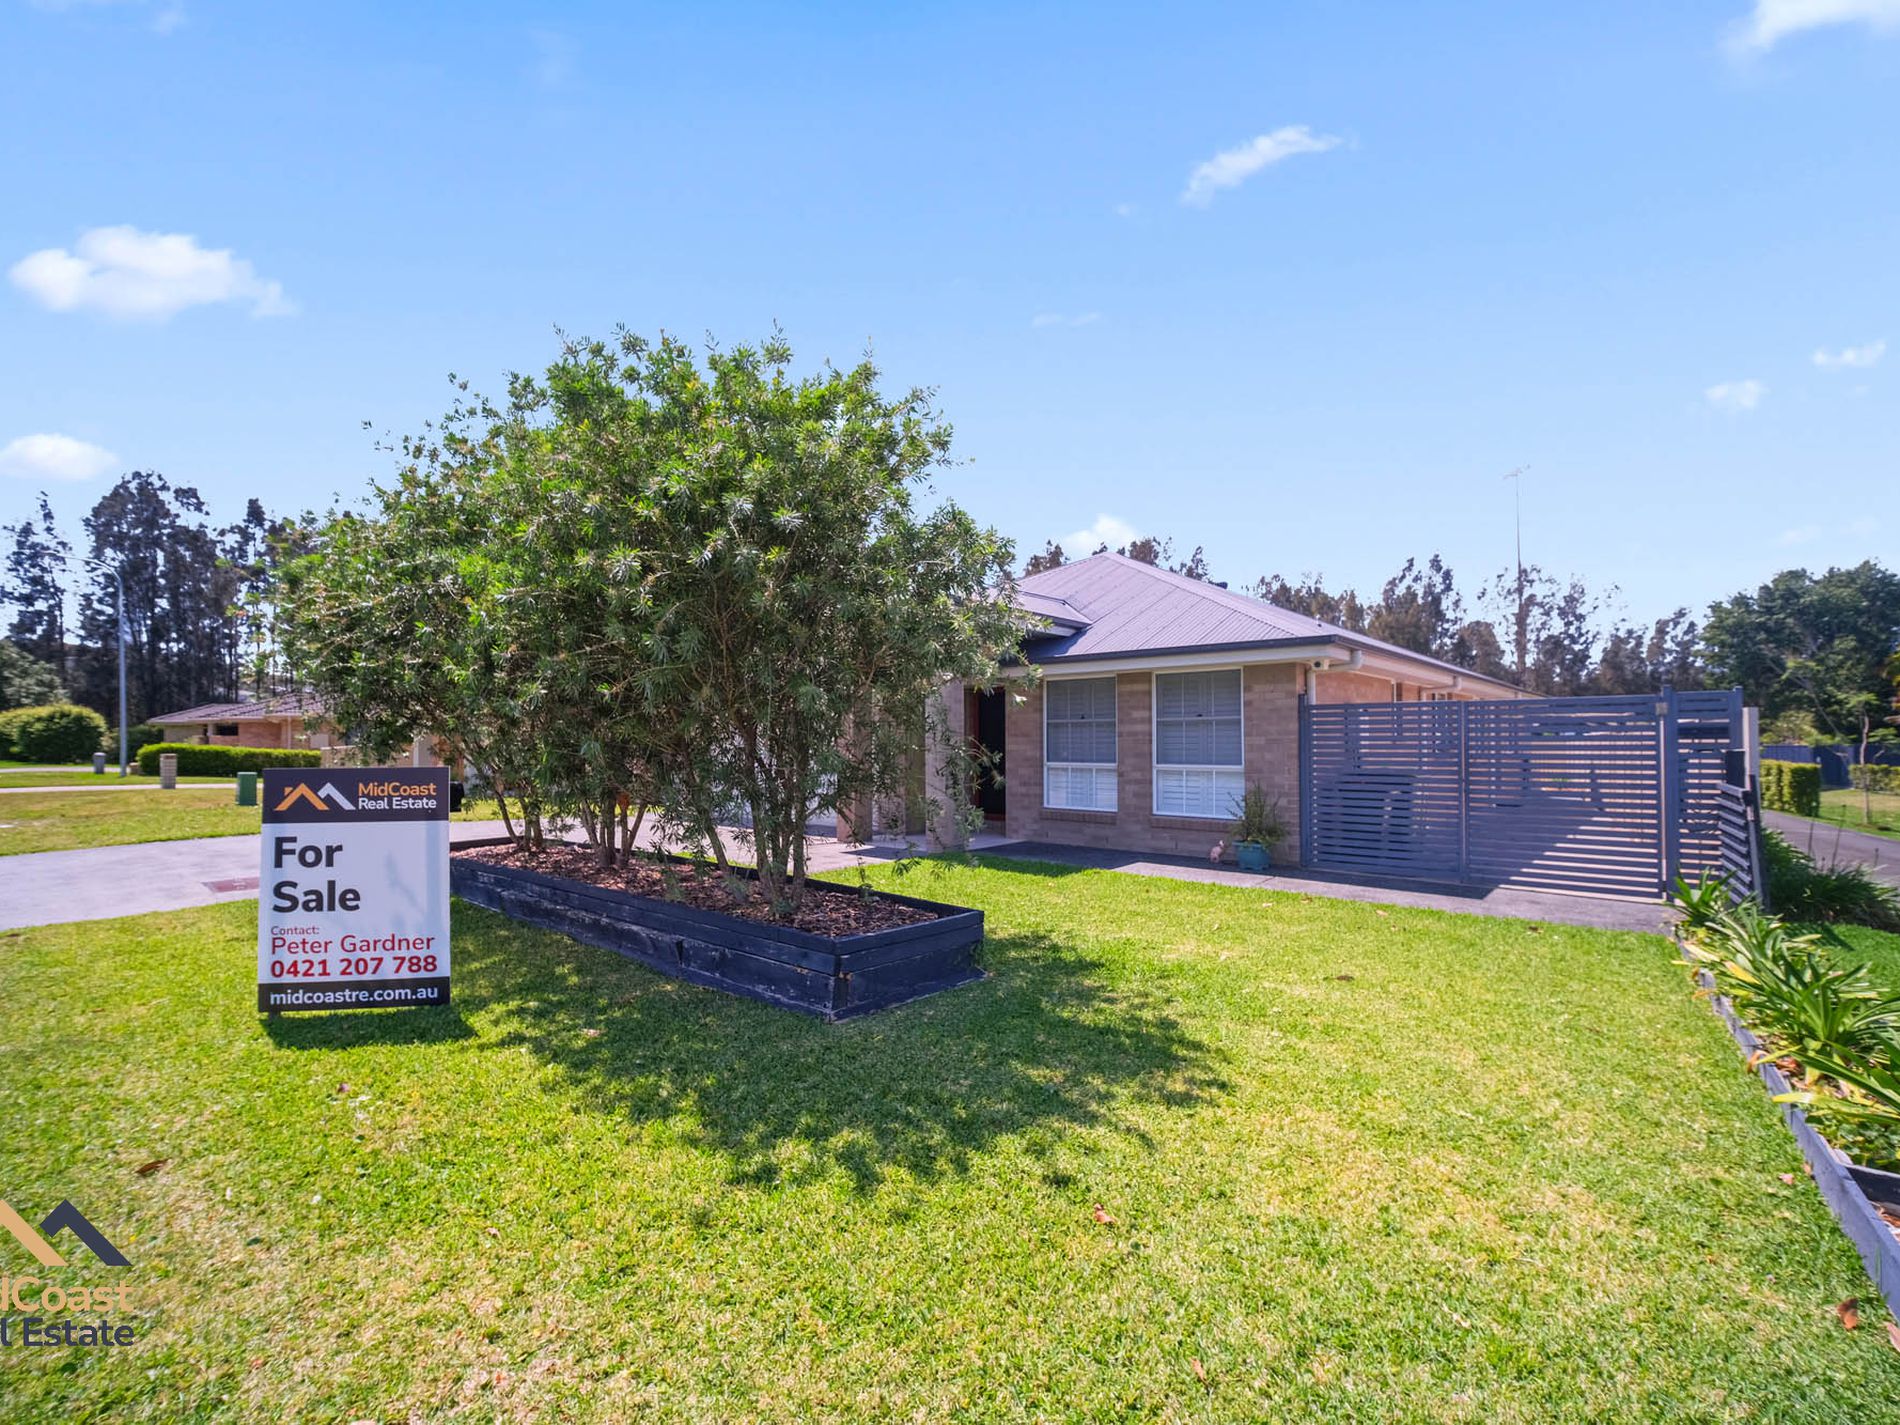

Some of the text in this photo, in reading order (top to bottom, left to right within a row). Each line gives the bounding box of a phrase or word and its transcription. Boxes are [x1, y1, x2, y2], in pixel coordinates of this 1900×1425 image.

[358, 782, 437, 797] MidCoast
[358, 797, 437, 810] Real Estate
[274, 836, 343, 869] For
[272, 880, 361, 913] Sale
[271, 926, 320, 936] Contact:
[271, 933, 435, 955] Peter Gardner
[270, 955, 438, 978] 0421 207 788
[270, 987, 438, 1005] midcoastre.com.au
